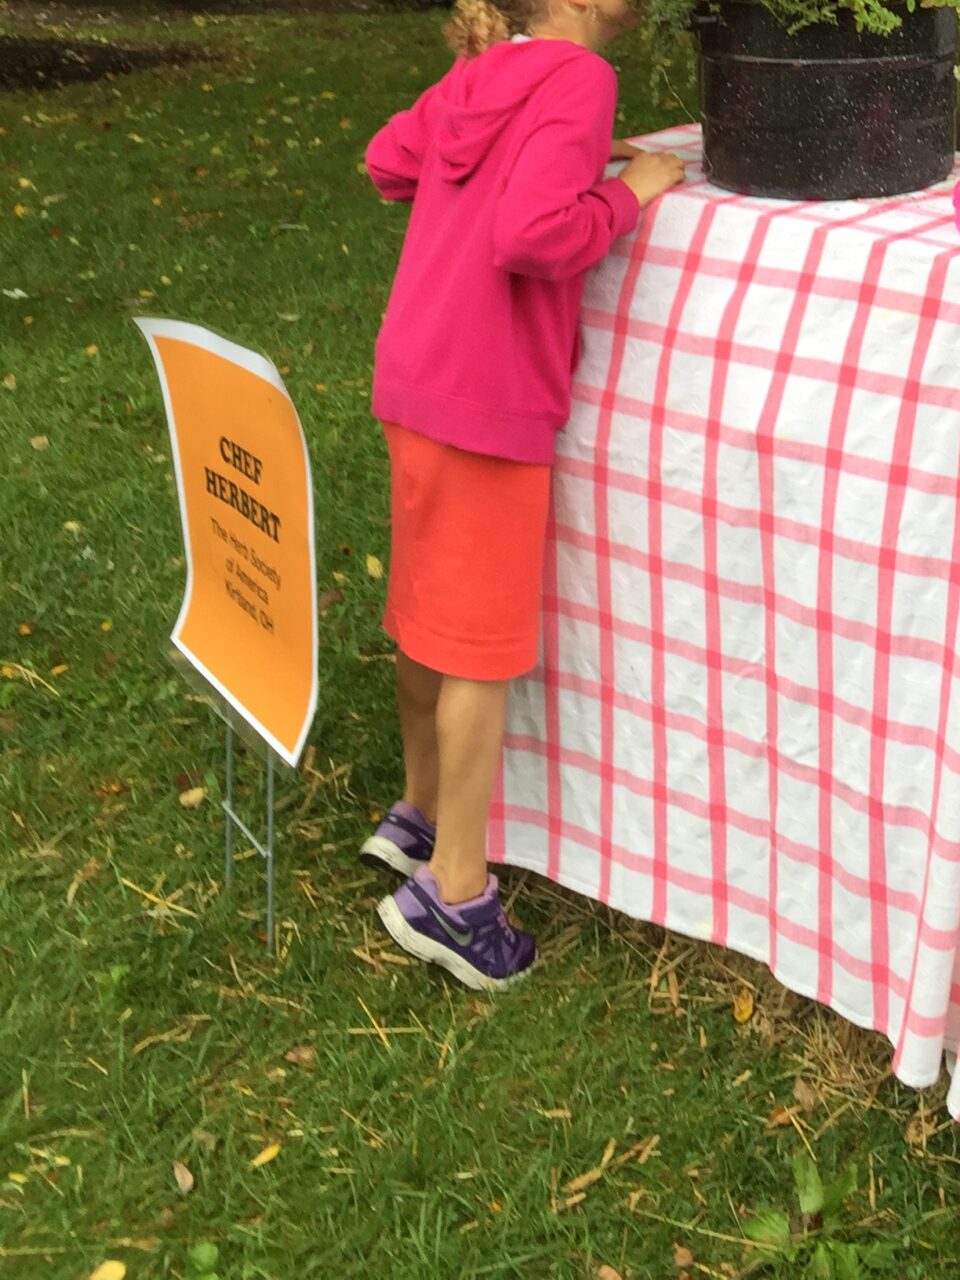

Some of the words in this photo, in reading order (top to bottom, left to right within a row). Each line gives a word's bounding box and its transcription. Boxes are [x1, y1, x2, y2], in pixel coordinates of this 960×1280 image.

[219, 435, 263, 487] CHEF
[204, 466, 282, 544] HERBERT
[210, 516, 228, 545] The
[249, 546, 282, 592] Society
[235, 567, 270, 607] America
